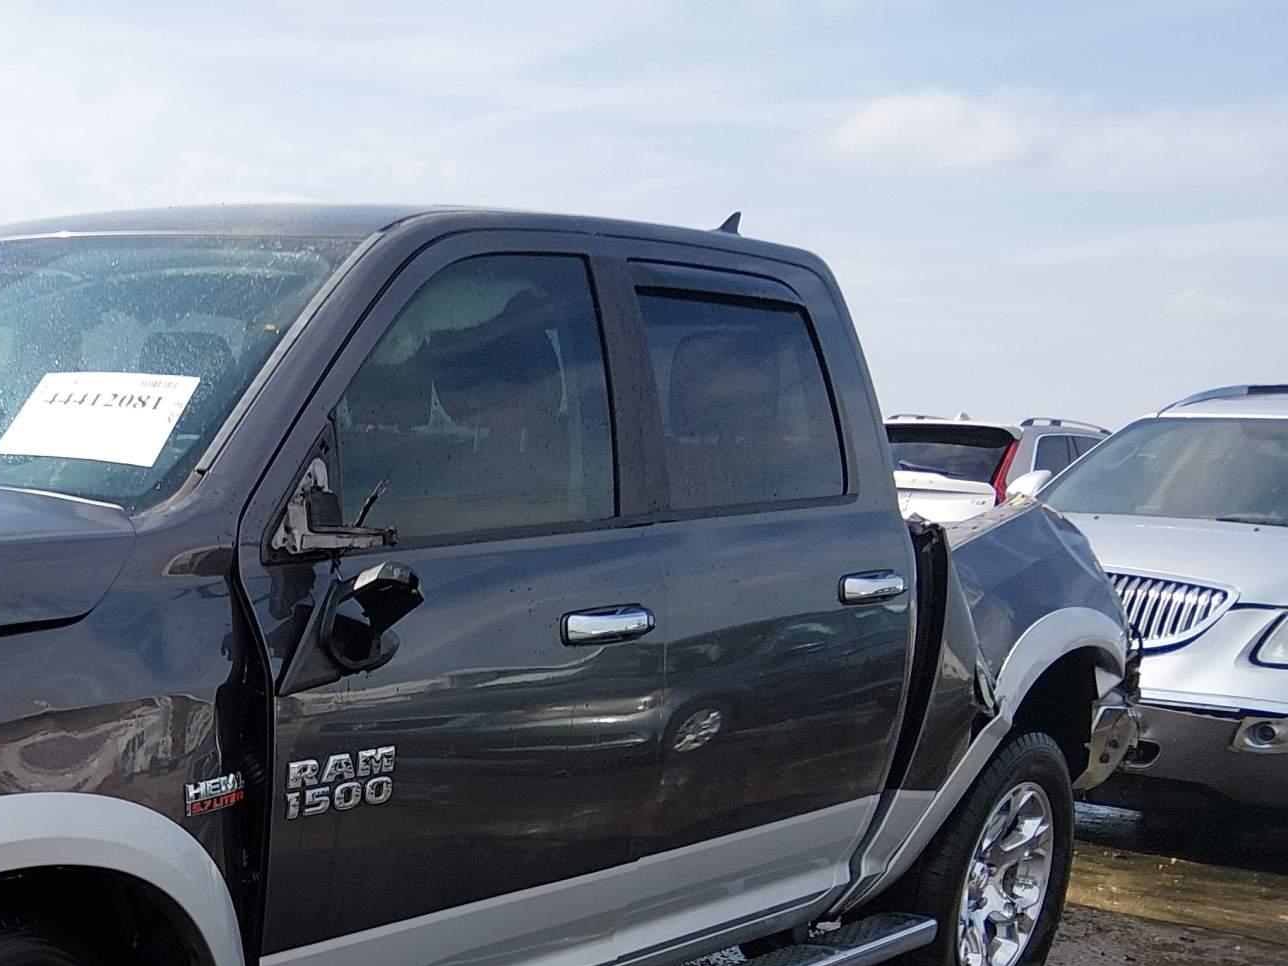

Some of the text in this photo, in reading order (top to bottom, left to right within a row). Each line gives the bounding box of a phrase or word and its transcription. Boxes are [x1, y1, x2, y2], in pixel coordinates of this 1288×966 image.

[43, 392, 163, 410] 44412081
[288, 746, 396, 788] RAM
[285, 776, 393, 820] 1500
